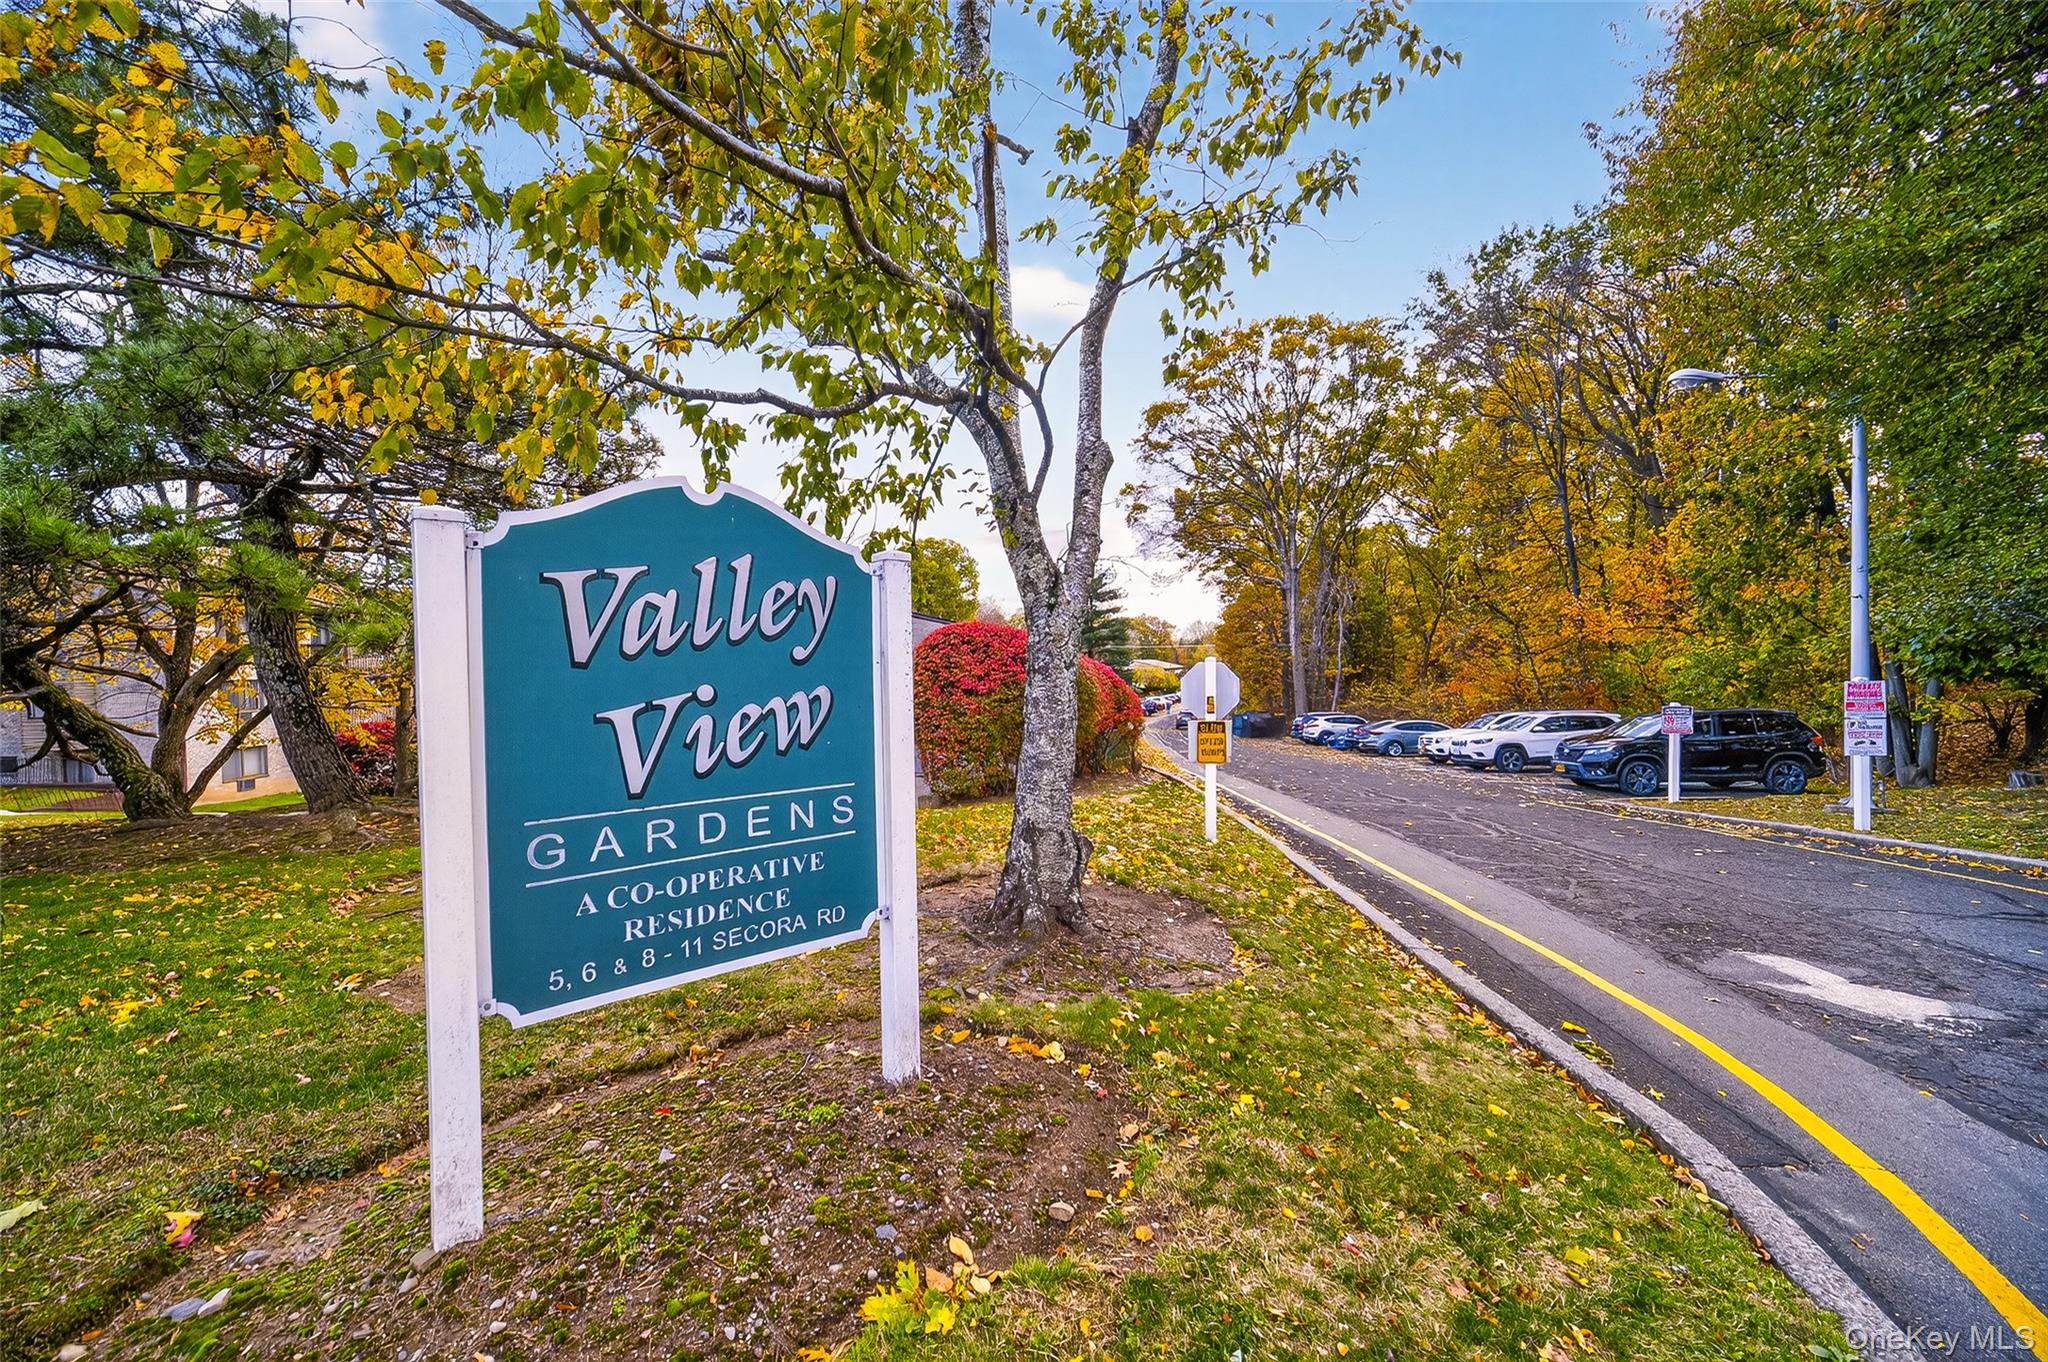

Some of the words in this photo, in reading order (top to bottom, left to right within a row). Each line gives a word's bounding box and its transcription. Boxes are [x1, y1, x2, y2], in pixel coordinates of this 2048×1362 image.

[540, 553, 838, 669] Valley
[593, 684, 834, 799] View
[525, 795, 855, 871] GARDENS
[575, 892, 599, 917] A
[606, 851, 825, 910] CO-OPERATIVE
[623, 887, 792, 943] RESIDENCE
[548, 969, 572, 991] 5,
[581, 961, 597, 983] 6
[613, 958, 628, 975] &
[641, 948, 656, 968] 8
[680, 937, 702, 959] 11
[711, 913, 807, 951] SECORA
[816, 905, 846, 927] RD
